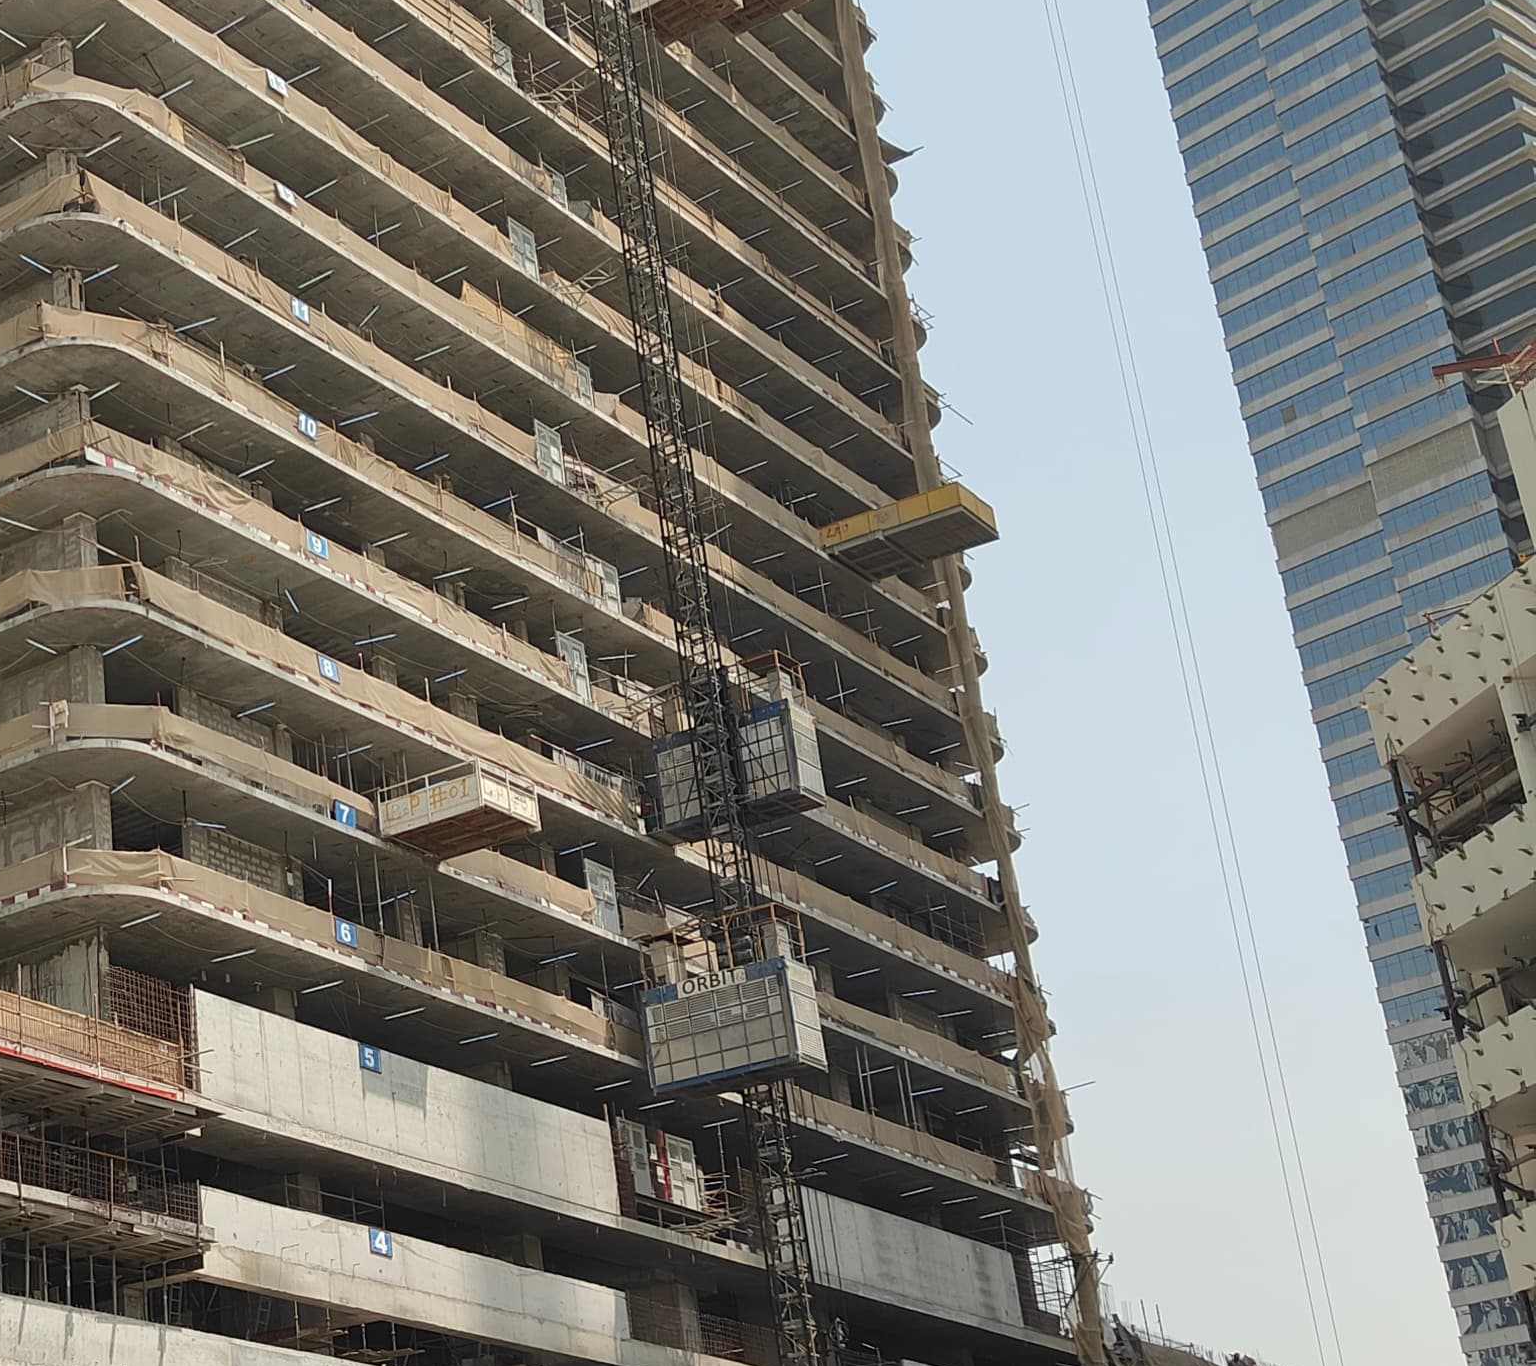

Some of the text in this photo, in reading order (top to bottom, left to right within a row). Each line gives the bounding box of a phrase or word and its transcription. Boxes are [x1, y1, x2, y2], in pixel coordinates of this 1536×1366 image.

[298, 413, 317, 437] 10
[312, 536, 322, 553] 9
[323, 659, 334, 677] 8
[339, 803, 350, 823] 7
[340, 923, 351, 942] 6
[682, 969, 735, 994] ORBIT
[364, 1047, 375, 1067] 5
[375, 1231, 388, 1254] 4
